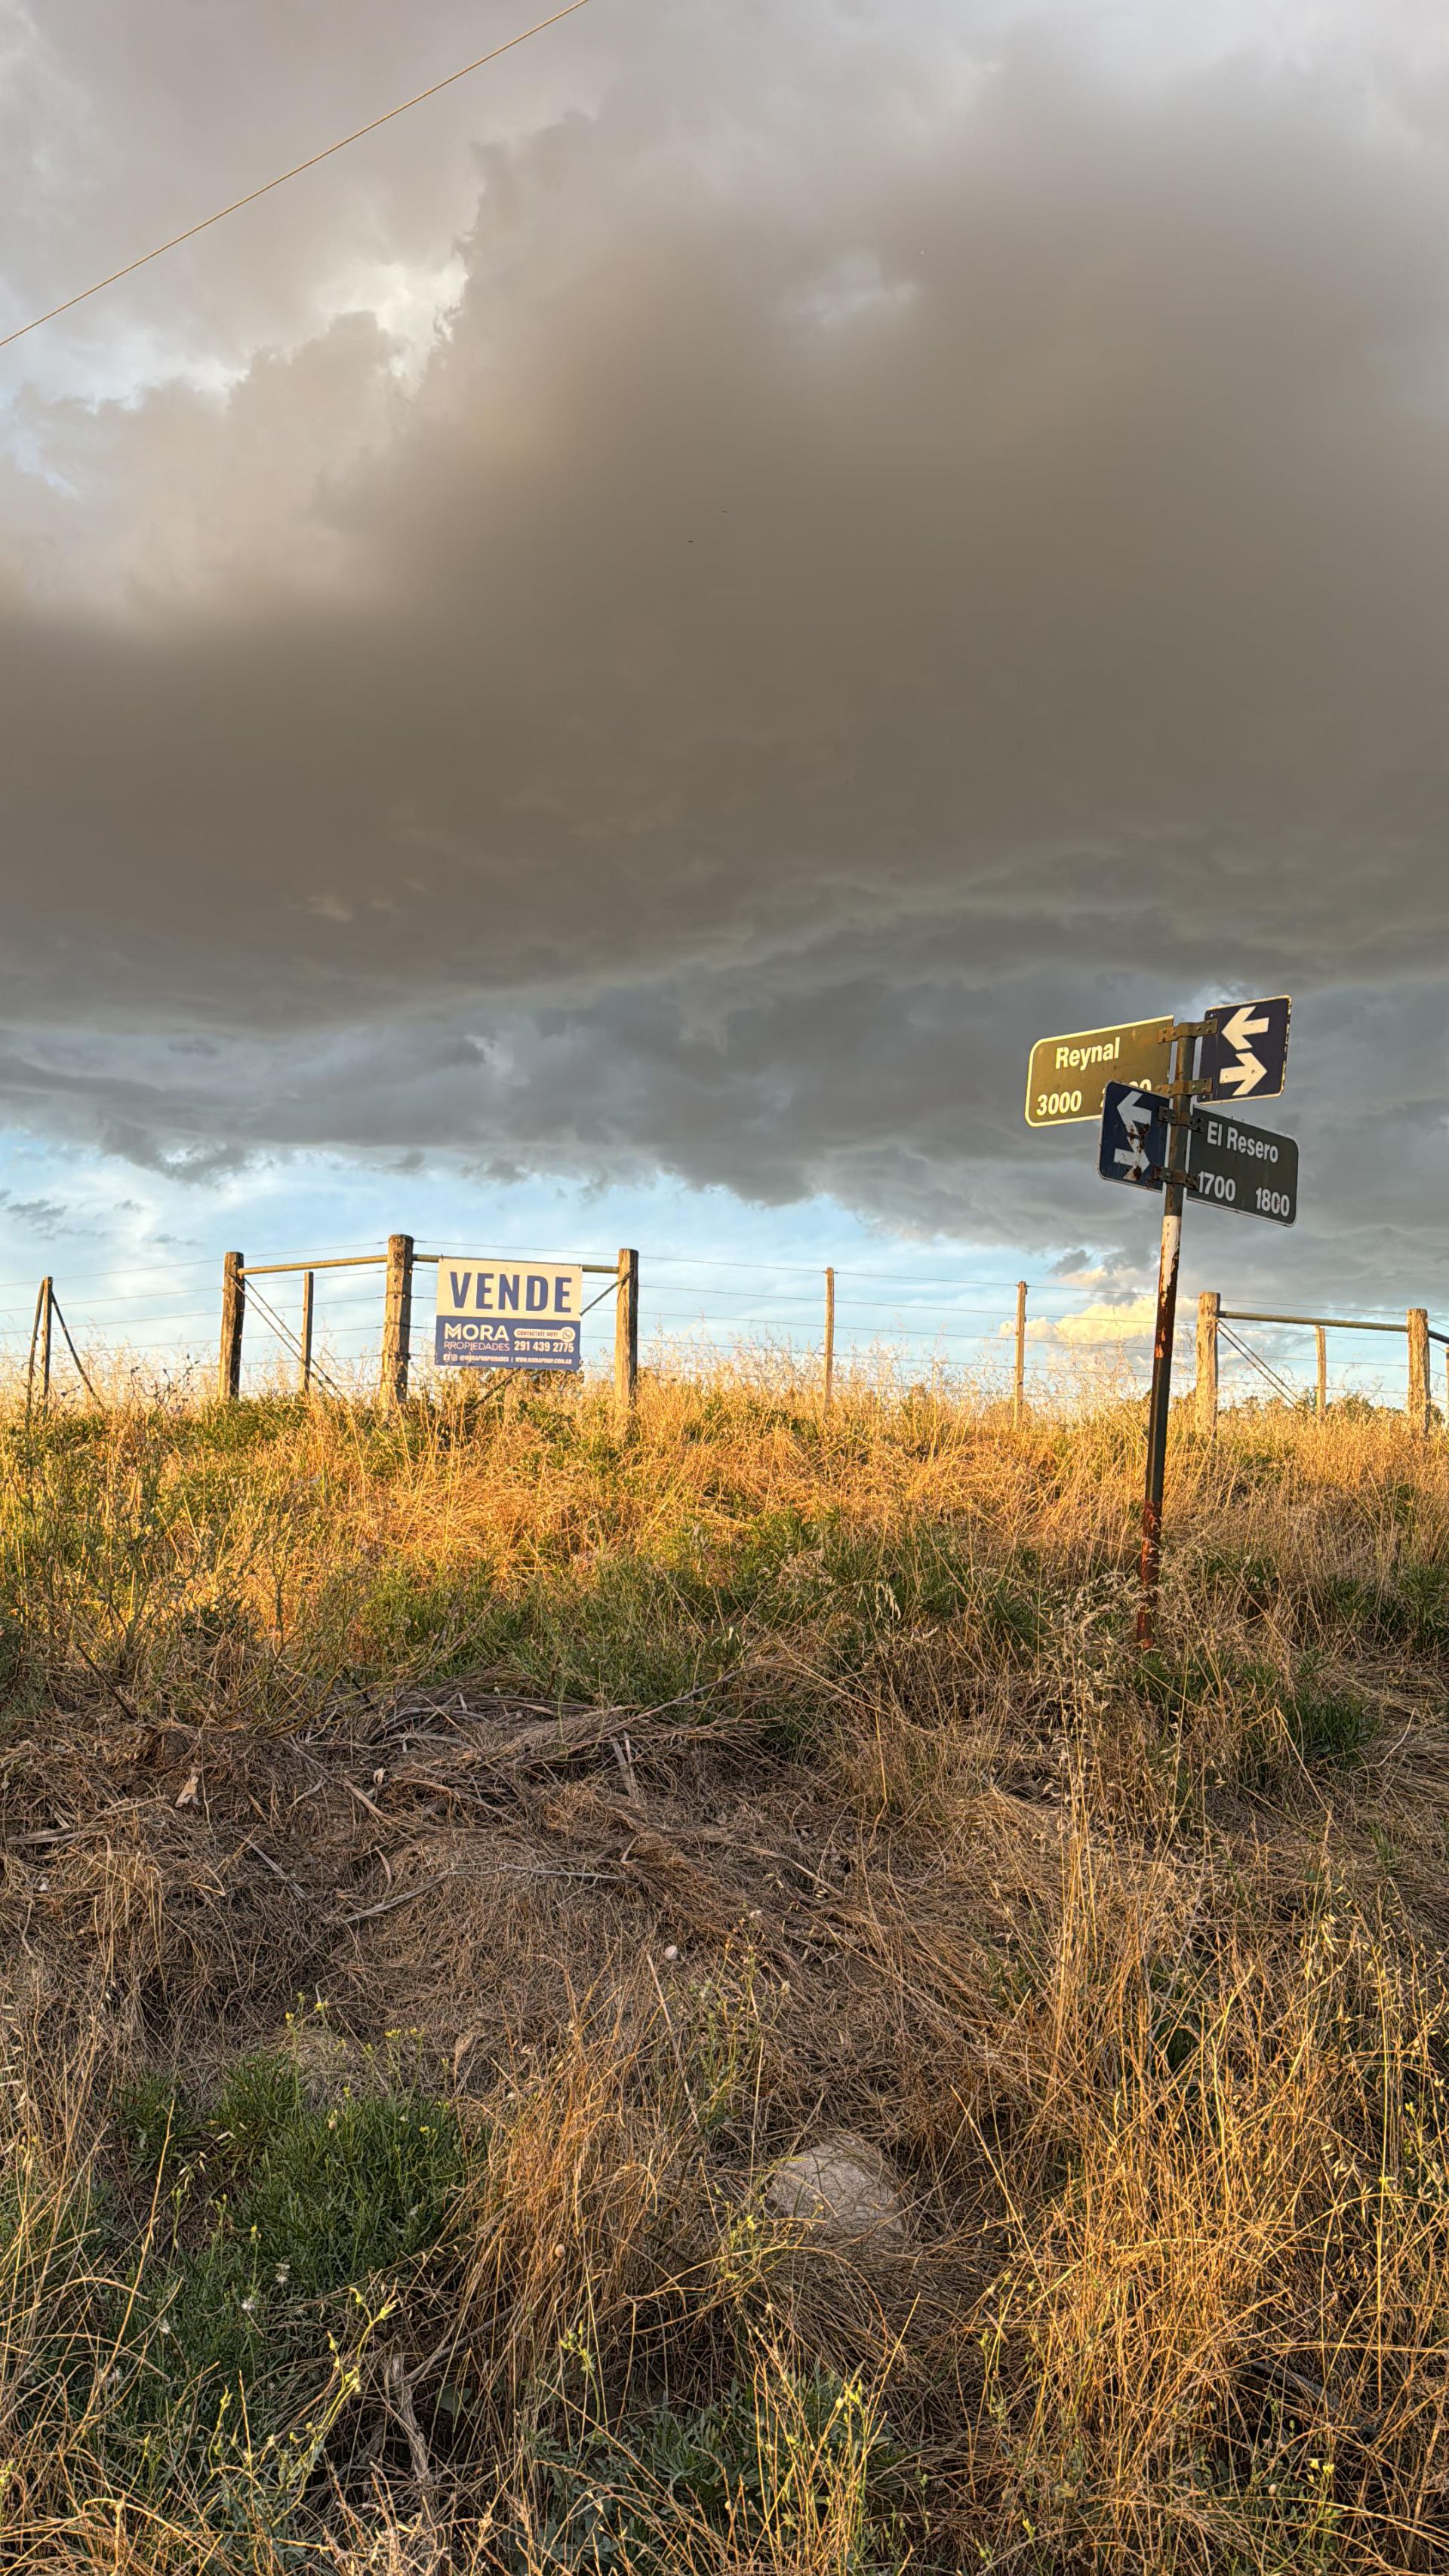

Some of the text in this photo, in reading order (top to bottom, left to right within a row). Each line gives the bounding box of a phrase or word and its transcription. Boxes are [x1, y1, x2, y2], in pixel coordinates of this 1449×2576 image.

[1055, 1036, 1121, 1071] Reynal
[1036, 1090, 1082, 1116] 3000
[1207, 1120, 1279, 1163] El Resero
[1198, 1171, 1291, 1217] 1700 1800
[450, 1271, 573, 1313] VENDE
[444, 1322, 509, 1341] MORA
[444, 1341, 510, 1352] PROPIEDADES
[514, 1340, 574, 1353] 291 439 2775
